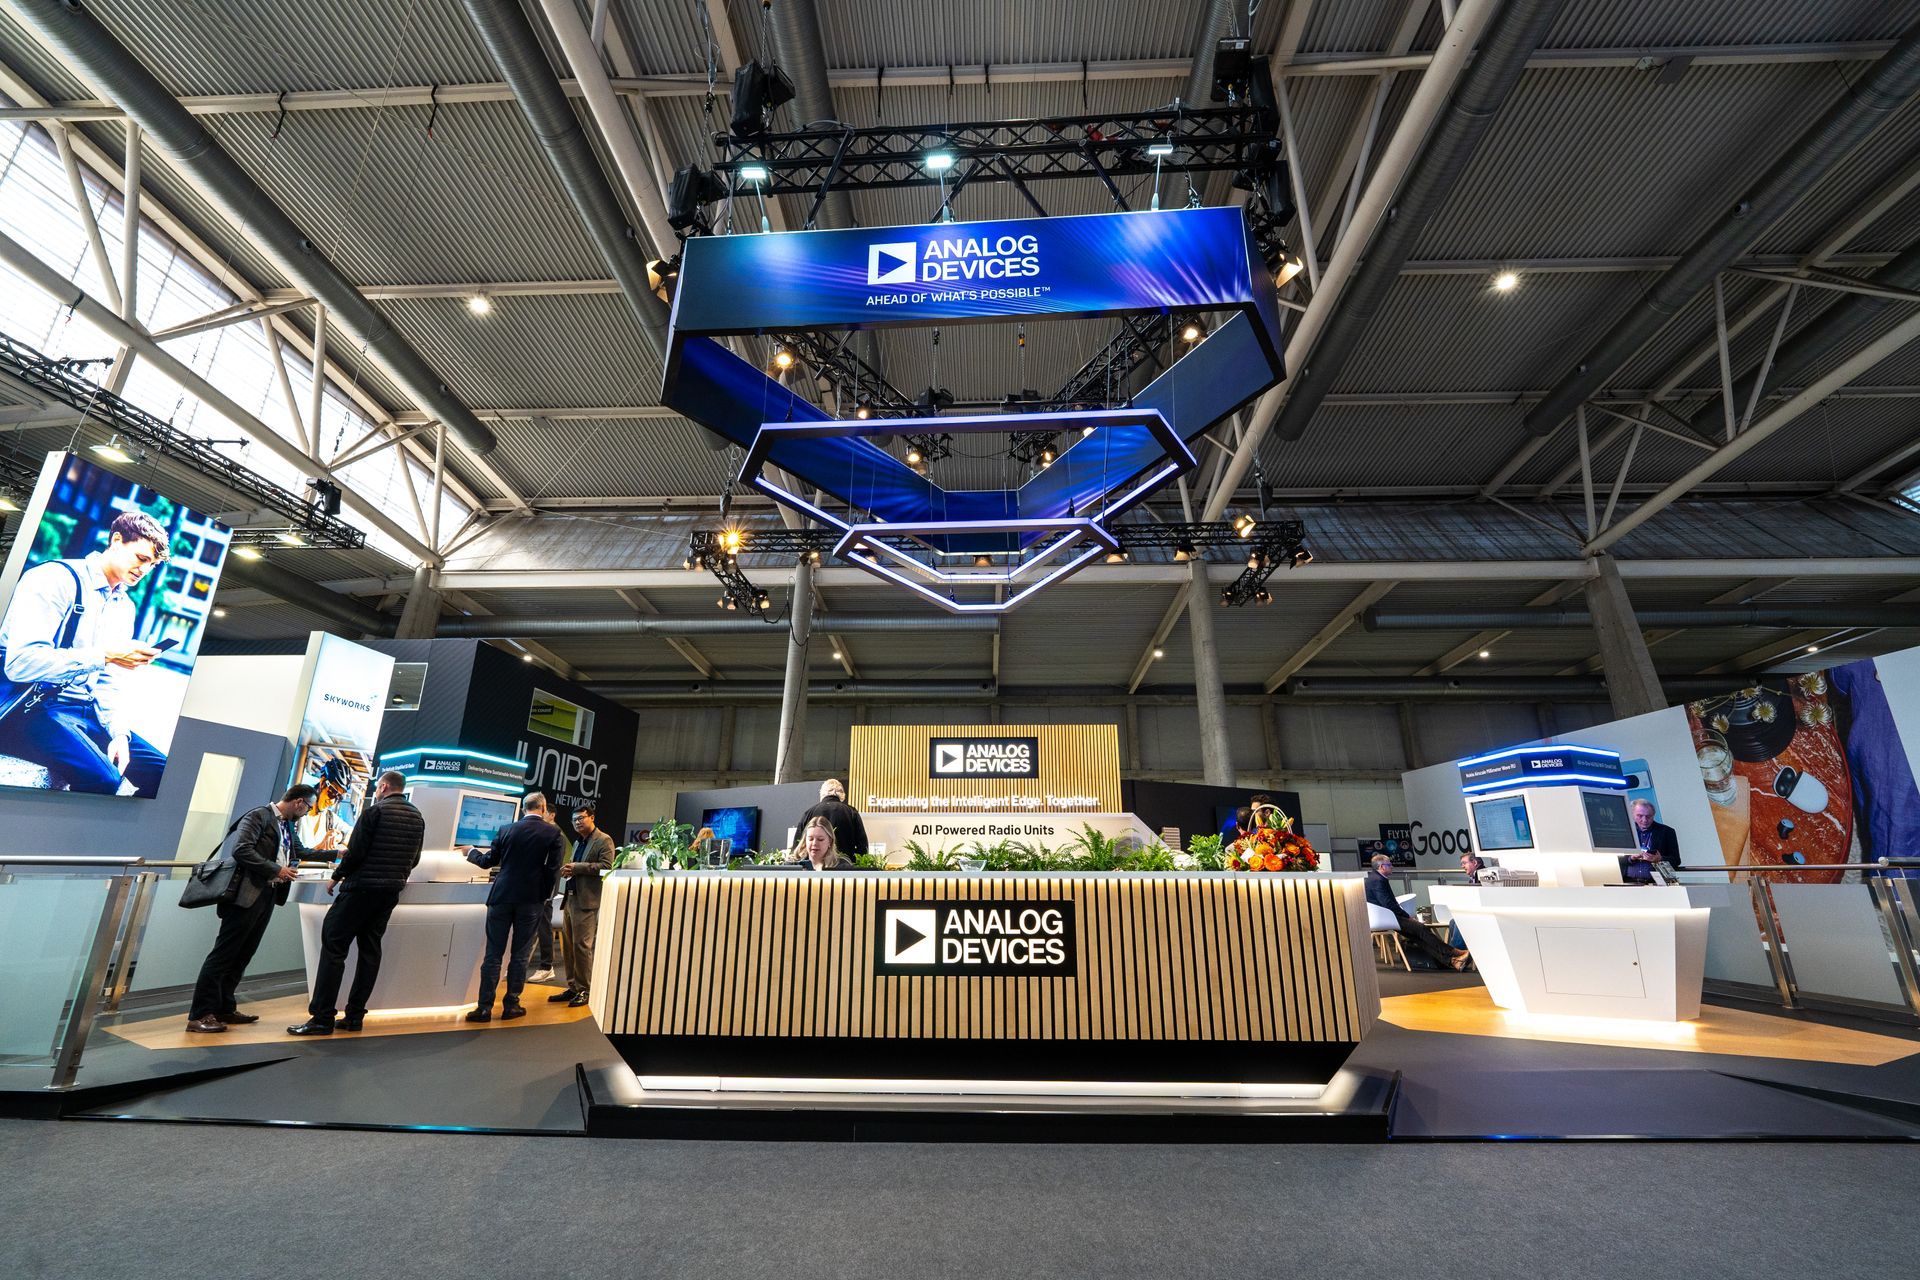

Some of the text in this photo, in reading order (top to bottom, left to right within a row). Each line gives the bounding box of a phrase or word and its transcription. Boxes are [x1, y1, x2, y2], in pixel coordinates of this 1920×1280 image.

[923, 234, 1039, 260] ANALOG
[922, 256, 1040, 282] DEVICES
[866, 293, 908, 306] AHEAD
[911, 293, 927, 303] OF
[931, 290, 978, 303] WHAT'S
[323, 693, 371, 712] SKYWORKS
[966, 744, 1030, 758] ANALOG
[965, 758, 1031, 773] DEVICES
[555, 793, 597, 811] NETWORKS
[868, 795, 1101, 809] Expanding the Intelligent Edge. Together.
[912, 824, 1055, 836] ADI Powered Radio Units
[1387, 829, 1410, 839] FLYTX
[1410, 820, 1473, 856] Goog
[943, 909, 1063, 935] ANALOG
[942, 938, 1065, 965] DEVICES
